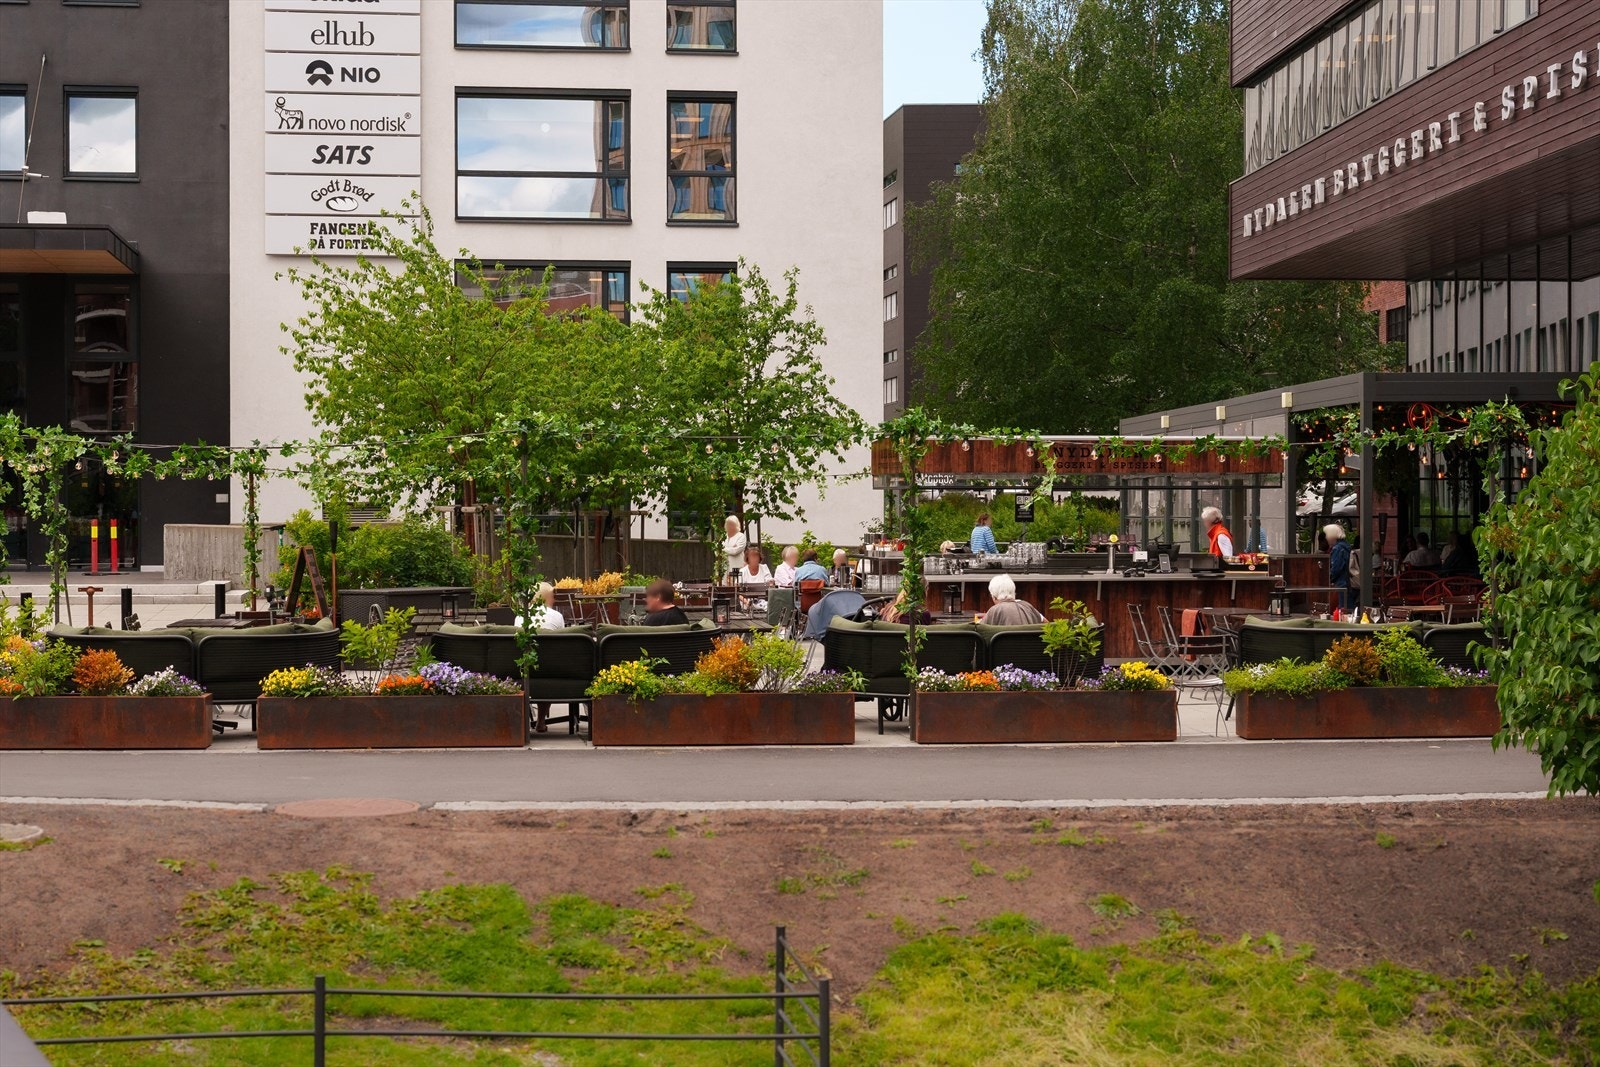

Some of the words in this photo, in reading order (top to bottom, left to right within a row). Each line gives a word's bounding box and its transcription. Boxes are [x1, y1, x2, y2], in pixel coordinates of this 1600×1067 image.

[310, 20, 375, 46] elhub
[340, 66, 381, 83] NIO
[308, 118, 346, 130] novo
[1333, 111, 1461, 196] BRYGGERI
[1473, 101, 1487, 133] &
[1501, 41, 1600, 121] SPIS
[311, 144, 375, 165] SATS
[310, 179, 340, 202] Godt
[343, 179, 375, 202] Brød
